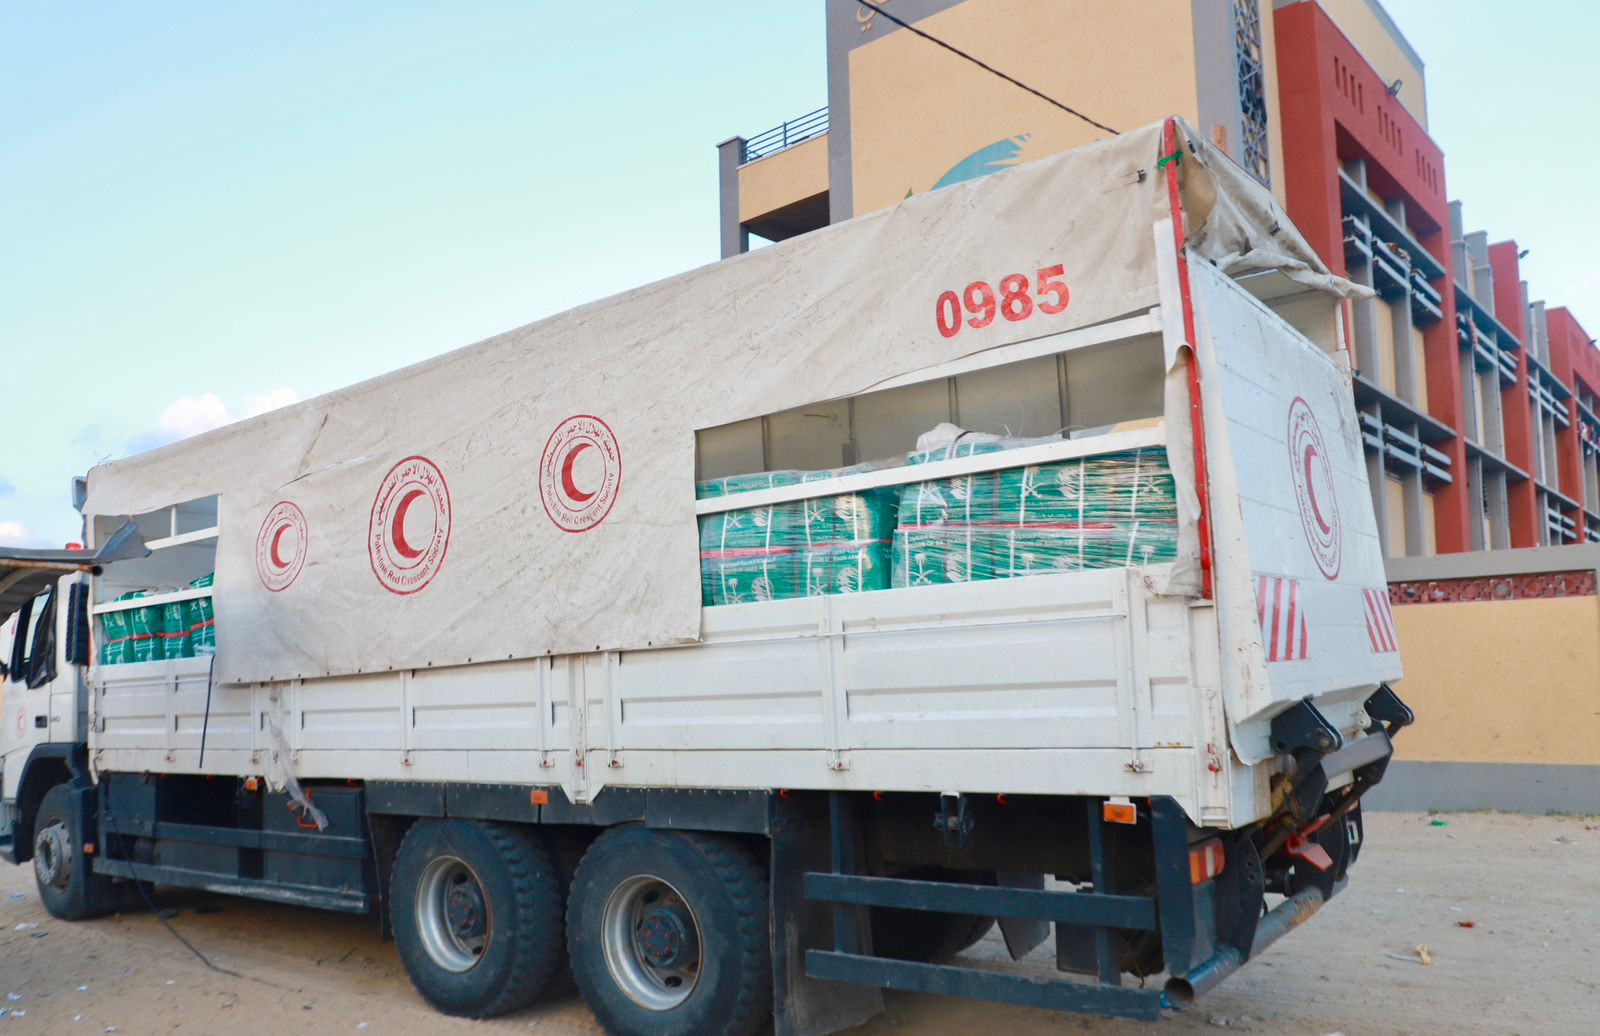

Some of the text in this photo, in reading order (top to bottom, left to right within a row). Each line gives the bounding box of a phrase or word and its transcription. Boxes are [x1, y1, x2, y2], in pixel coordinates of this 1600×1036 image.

[936, 263, 1070, 339] 0985
[600, 473, 614, 504] Society
[375, 534, 387, 574] Palestine
[388, 570, 401, 585] Red
[428, 529, 444, 564] Society
